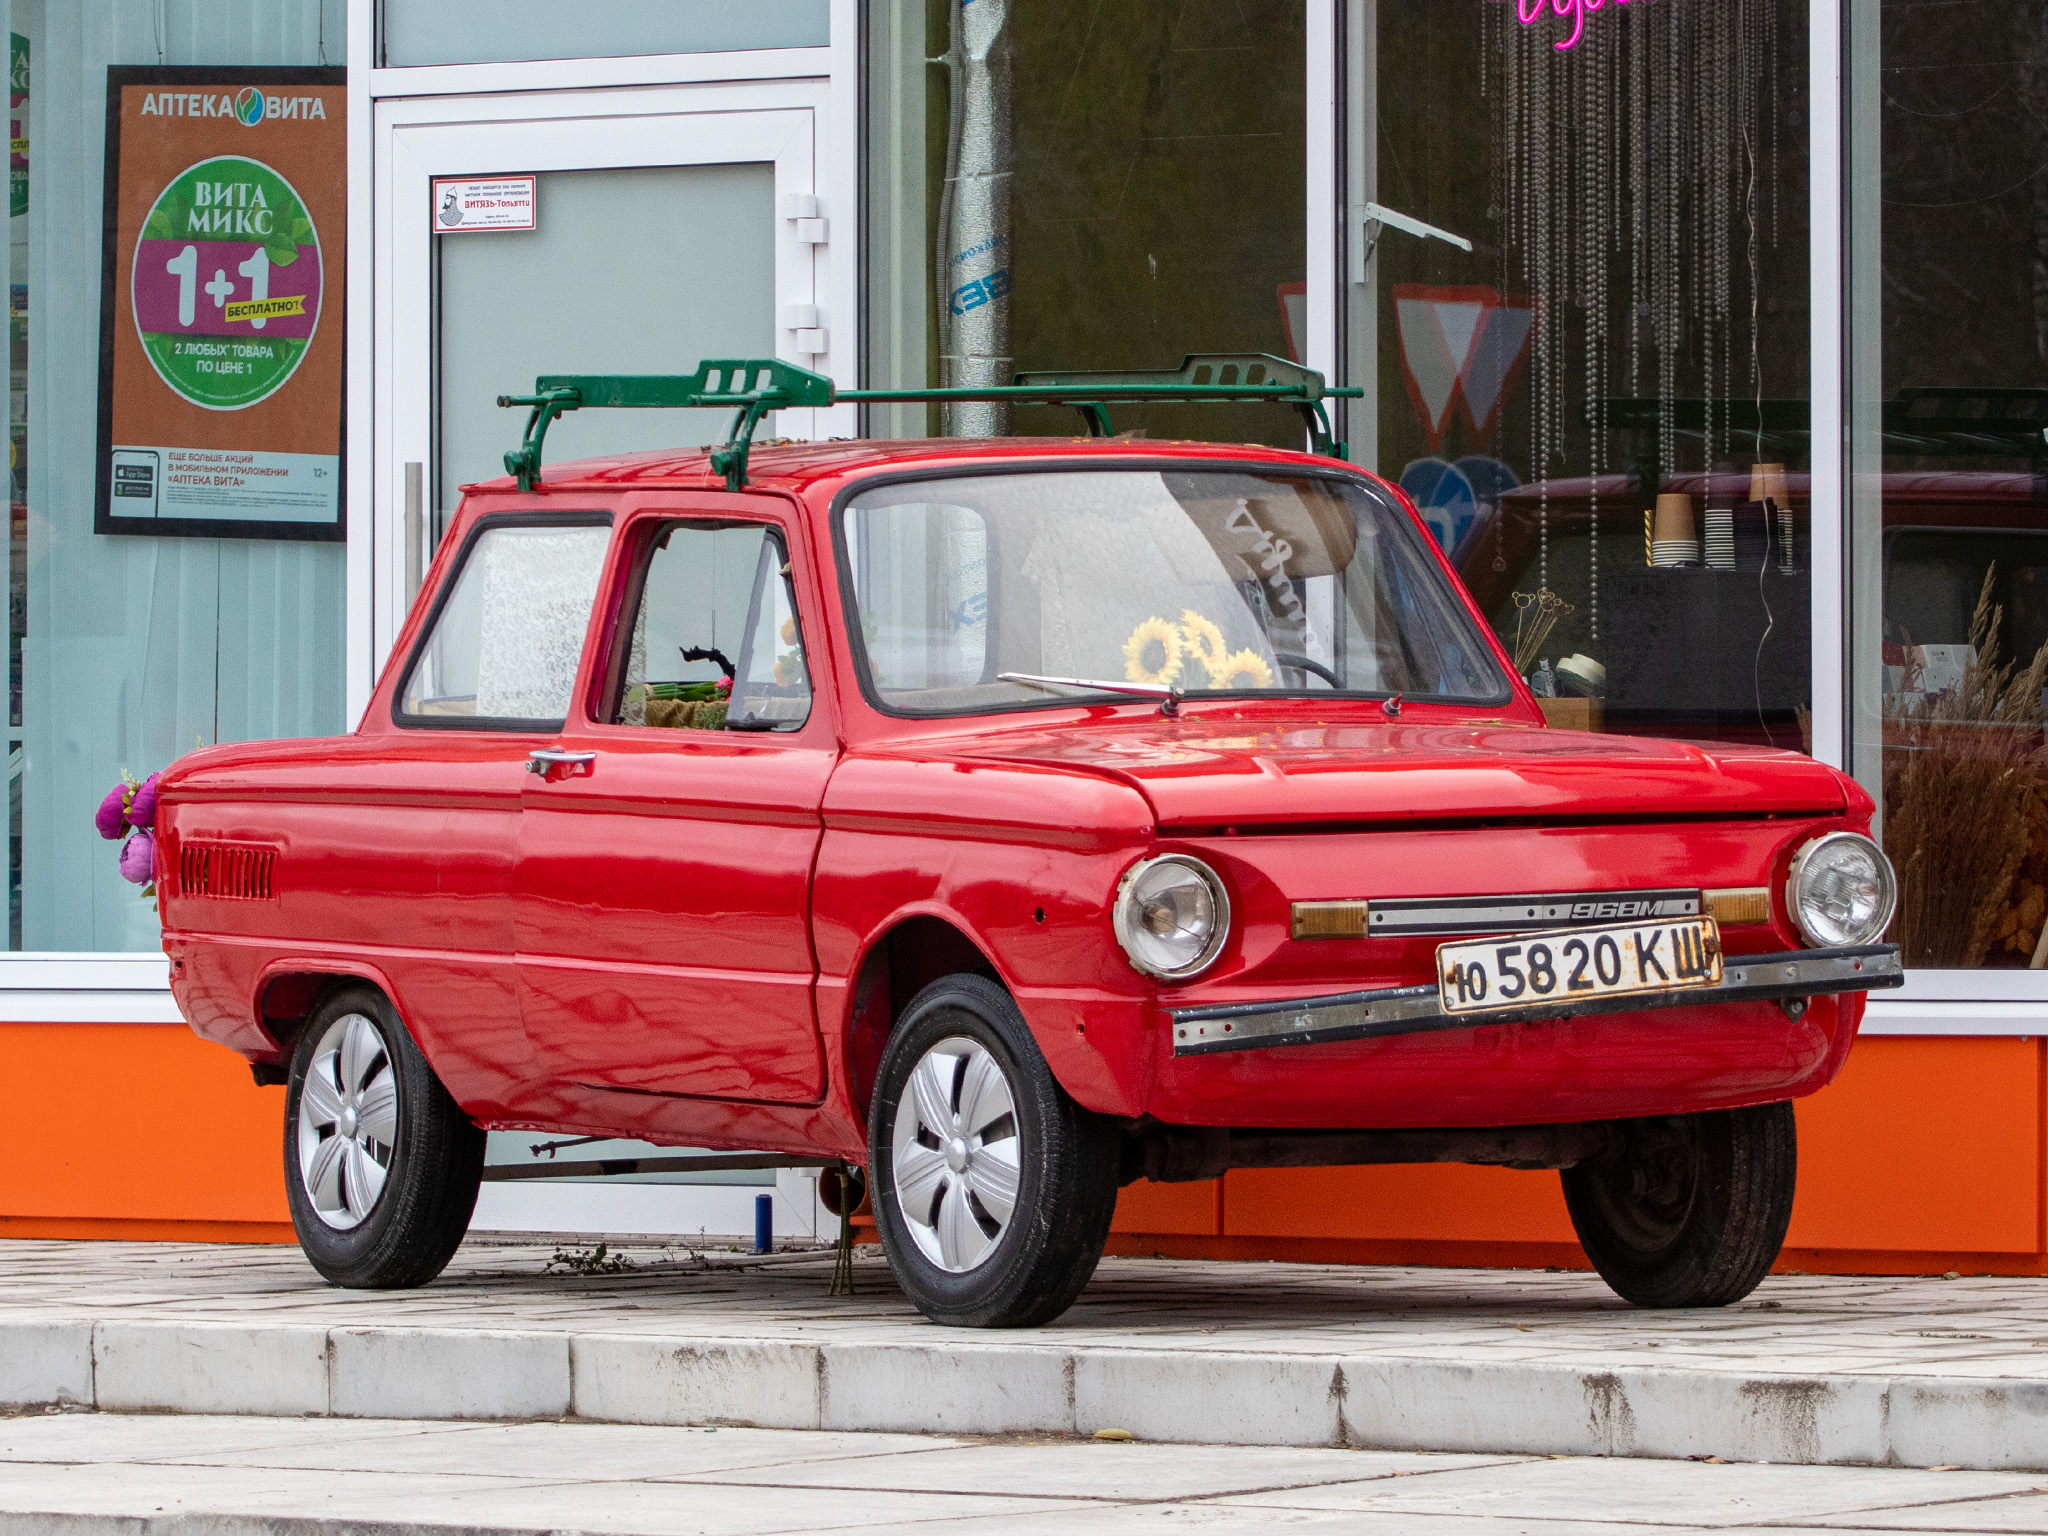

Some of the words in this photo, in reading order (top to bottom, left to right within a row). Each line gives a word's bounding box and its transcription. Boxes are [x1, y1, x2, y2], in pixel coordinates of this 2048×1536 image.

[141, 93, 235, 118] АПТЕКА
[265, 96, 326, 120] ВИТА
[195, 181, 268, 208] ВИТА
[464, 199, 530, 209] ВИТЯЗЬ-Тольятти
[187, 207, 273, 235] МИКС
[174, 343, 183, 355] 2
[232, 344, 274, 358] ТОВАРА
[196, 360, 214, 372] ПО
[215, 361, 244, 375] ЦЕНЕ
[246, 363, 253, 375] 1
[168, 452, 187, 462] ЕЩЕ
[188, 453, 223, 463] БОЛЬШЕ
[225, 454, 254, 464] АКЦИЙ
[168, 464, 174, 472] В
[175, 464, 229, 473] МОБИЛЬНОМ
[230, 466, 289, 477] ПРИЛОЖЕНИИ
[313, 467, 328, 478] 12+
[168, 475, 211, 486] «АПТЕКА
[213, 476, 245, 488] ВИТА»
[1495, 934, 1622, 999] 5820
[1633, 925, 1706, 984] КШ
